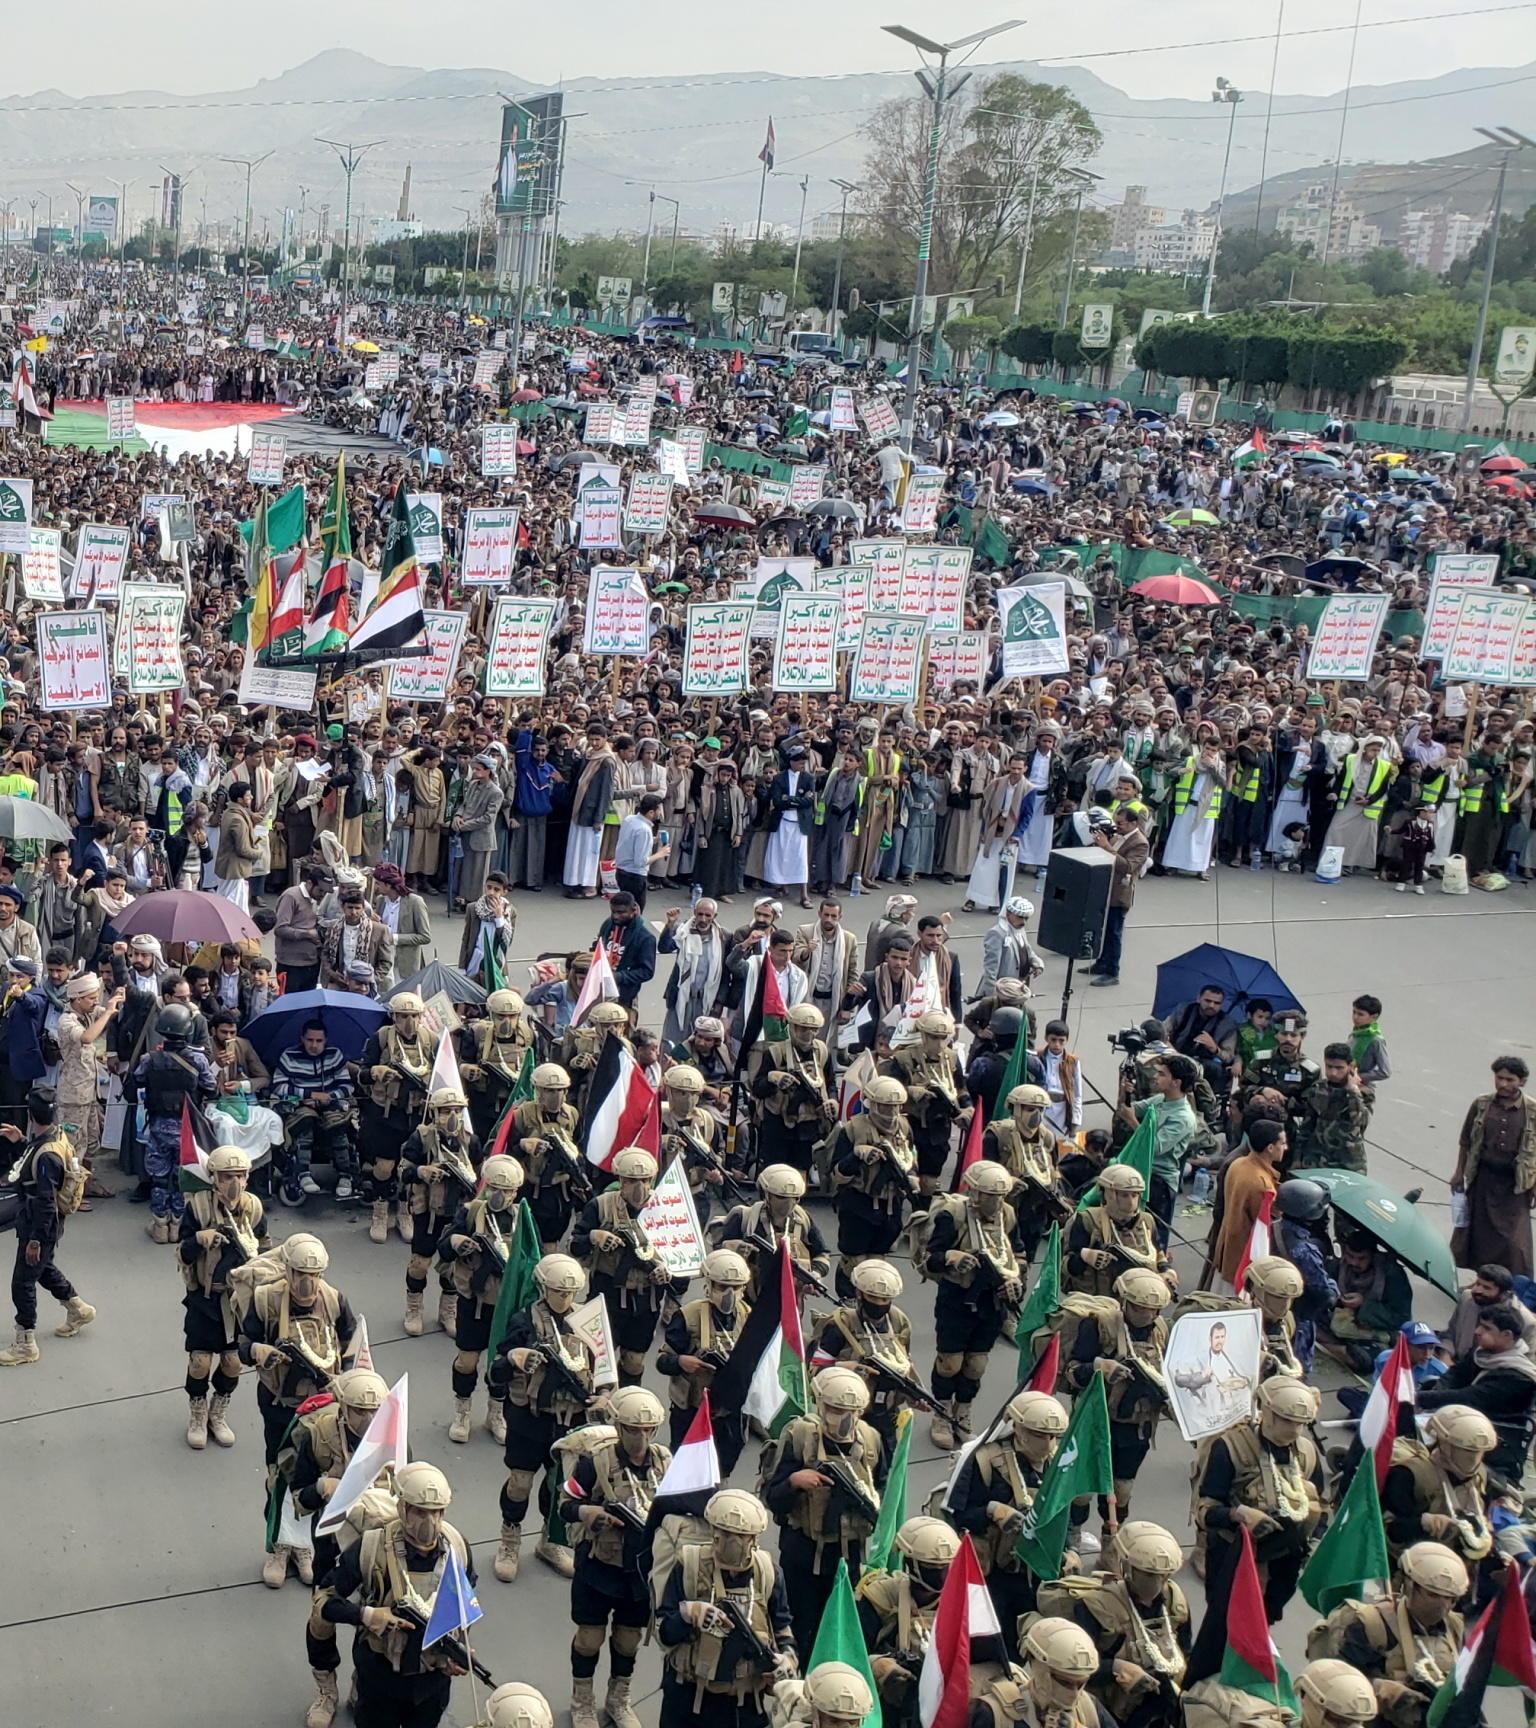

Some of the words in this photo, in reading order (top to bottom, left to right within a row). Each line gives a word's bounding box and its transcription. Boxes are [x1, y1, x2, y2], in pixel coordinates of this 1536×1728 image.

[728, 610, 749, 622] الله
[819, 604, 834, 616] الله
[529, 610, 548, 623] الله
[1013, 603, 1050, 636] محمد
[45, 617, 97, 641] قاطعوا
[724, 628, 745, 638] الموت
[812, 622, 833, 632] الموت
[899, 624, 920, 636] الله
[523, 628, 542, 640] الموت
[522, 643, 540, 652] الموت
[723, 643, 743, 653] الموت
[812, 638, 832, 648] الموت
[894, 640, 916, 651] الموت
[76, 644, 99, 662] البضائع
[782, 653, 801, 663] اليهود
[815, 654, 832, 662] اللعنة
[494, 658, 511, 669] اليهود
[512, 660, 522, 669] على
[524, 658, 538, 667] اللعنة
[690, 660, 710, 670] اليهود
[713, 660, 724, 671] على
[726, 657, 742, 666] اللعنة
[803, 654, 812, 665] على
[892, 655, 914, 665] الموت
[71, 664, 75, 678] و
[781, 666, 807, 681] للإسلام
[808, 667, 831, 682] النصر
[859, 670, 879, 678] اليهود
[880, 672, 891, 681] على
[895, 670, 911, 679] اللعنة
[493, 671, 516, 685] للإسلام
[518, 672, 538, 687] النصر
[689, 673, 717, 686] للإسلام
[718, 671, 741, 686] النصر
[857, 682, 885, 695] للإسلام
[889, 683, 911, 695] النصر
[662, 1192, 684, 1206] الموت
[669, 1212, 690, 1227] الموت
[678, 1232, 697, 1244] اللعنة
